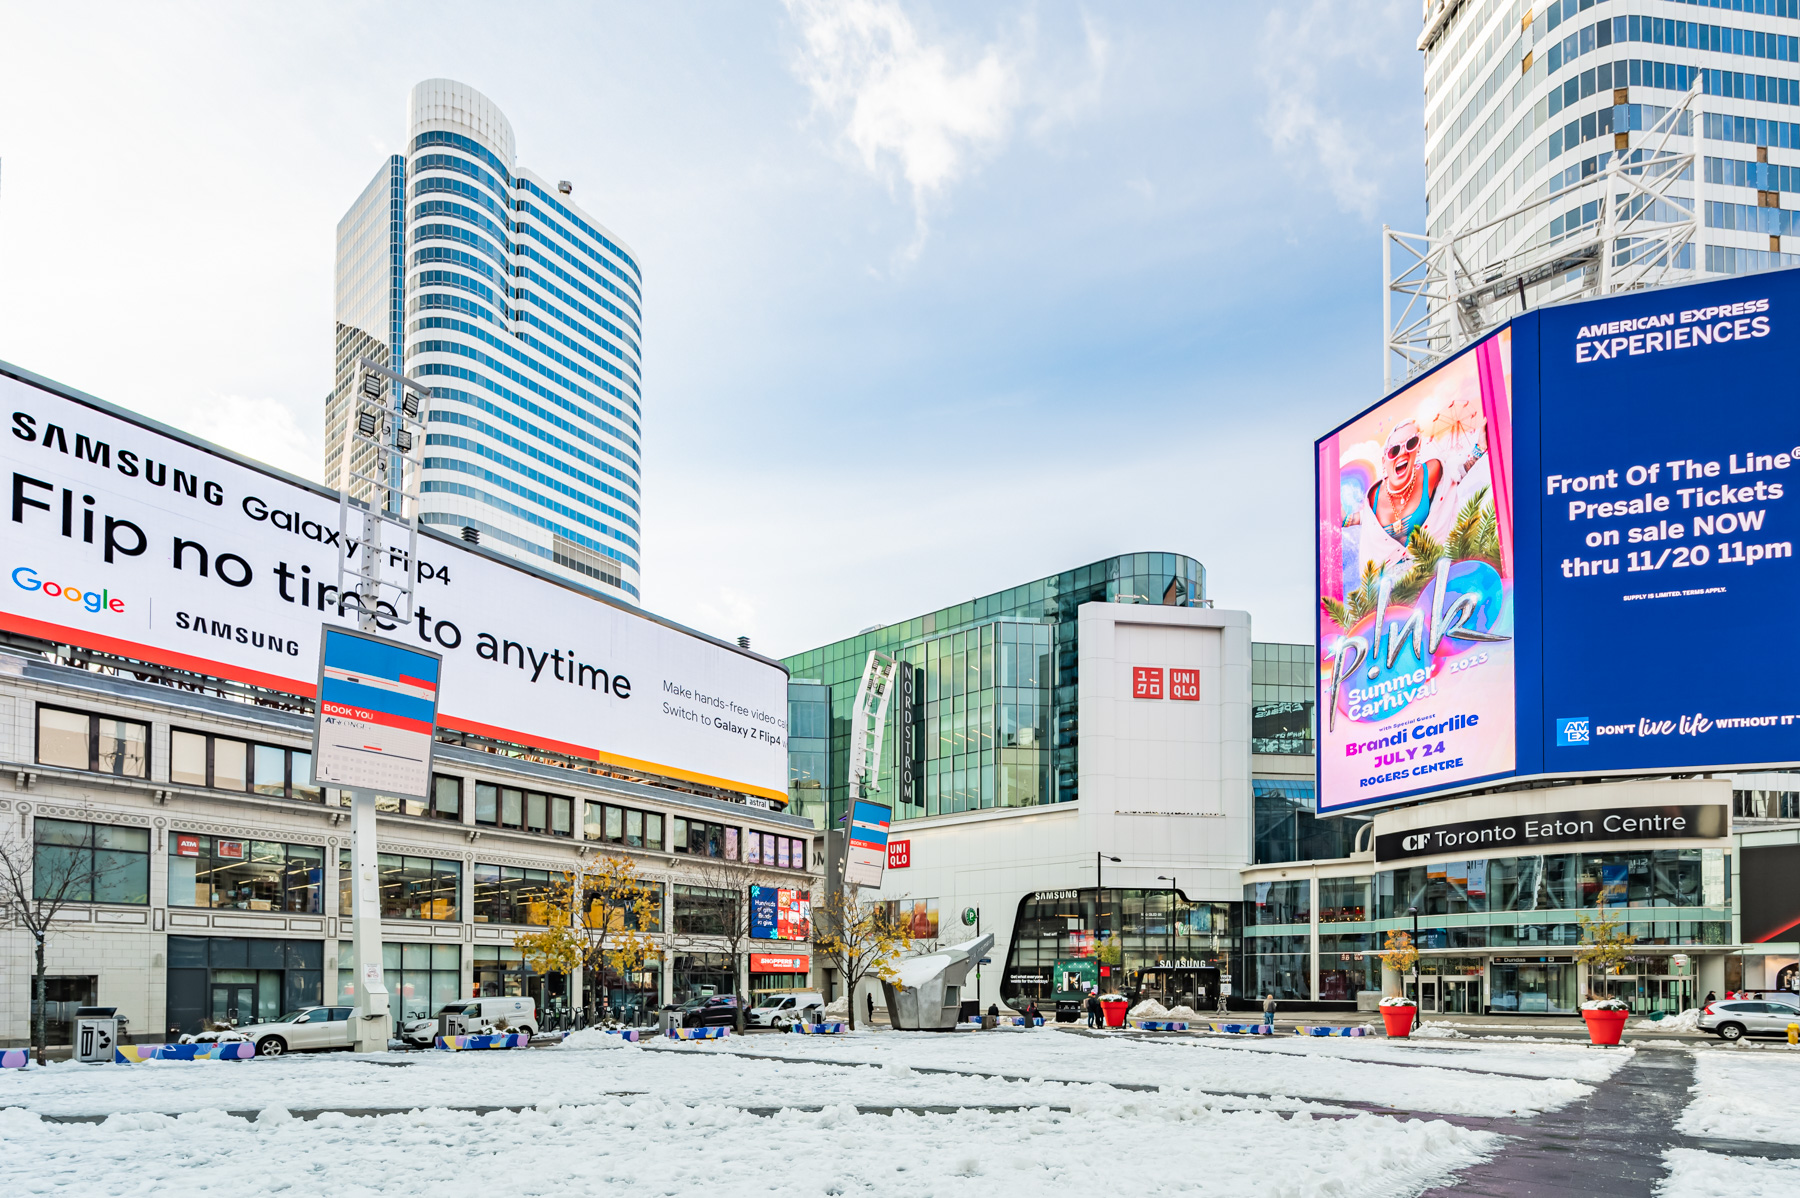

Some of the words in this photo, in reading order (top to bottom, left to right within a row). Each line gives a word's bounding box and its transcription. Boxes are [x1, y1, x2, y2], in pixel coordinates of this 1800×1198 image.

[1576, 313, 1675, 339] AMERICAN
[1679, 298, 1770, 324] EXPRESS
[1576, 316, 1771, 363] EXPERIENCES
[11, 411, 224, 507] SAMSUNG
[242, 496, 360, 559] Galaxy
[1547, 469, 1618, 495] Front
[1626, 463, 1660, 486] Of
[1666, 460, 1721, 482] The
[1569, 493, 1670, 521] Presale
[1676, 480, 1784, 509] Tickets
[1585, 528, 1619, 548] on
[1628, 520, 1685, 544] sale
[1694, 510, 1766, 537] NOW
[1561, 557, 1619, 578] thru
[1627, 545, 1710, 572] 11/20
[1718, 541, 1793, 566] 11pm
[11, 567, 125, 614] Google
[12, 471, 148, 564] Flip
[172, 536, 254, 588] no
[414, 606, 462, 649] to
[476, 631, 632, 700] anytime
[1623, 593, 1647, 602] SUPPLY
[1648, 592, 1654, 600] IS
[1682, 588, 1704, 597] TERMS
[175, 611, 300, 657] SAMSUNG
[1173, 672, 1195, 684] UNI
[1450, 651, 1489, 674] 2023
[663, 680, 692, 699] Make
[694, 689, 749, 717] hands-free
[751, 709, 776, 725] video
[1173, 685, 1197, 697] QLO
[1348, 663, 1436, 706] Summer
[1348, 677, 1439, 721] Carnival
[324, 703, 352, 717] BOOK
[662, 701, 698, 722] Switch
[701, 714, 711, 726] to
[713, 717, 748, 739] Galaxy
[750, 727, 757, 739] Z
[759, 730, 781, 746] Flip4
[1393, 718, 1416, 730] Special
[1416, 713, 1436, 724] Guest
[1638, 717, 1677, 737] live
[1678, 712, 1714, 737] life
[1715, 716, 1779, 729] WITHOUT
[904, 666, 912, 798] NORDSTROM
[1346, 728, 1408, 757] Brandi
[1411, 713, 1480, 740] Carlile
[1360, 768, 1410, 788] ROGERS
[1411, 757, 1464, 776] CENTRE
[1374, 747, 1418, 768] JULY
[1422, 740, 1446, 758] 24
[748, 798, 767, 809] astral
[890, 843, 906, 854] UNI
[1402, 832, 1431, 853] CF
[1435, 824, 1517, 848] Toronto
[1525, 817, 1594, 838] Eaton
[1603, 813, 1687, 834] Centre
[890, 854, 907, 867] QLO
[1035, 890, 1078, 900] SAMSUNG
